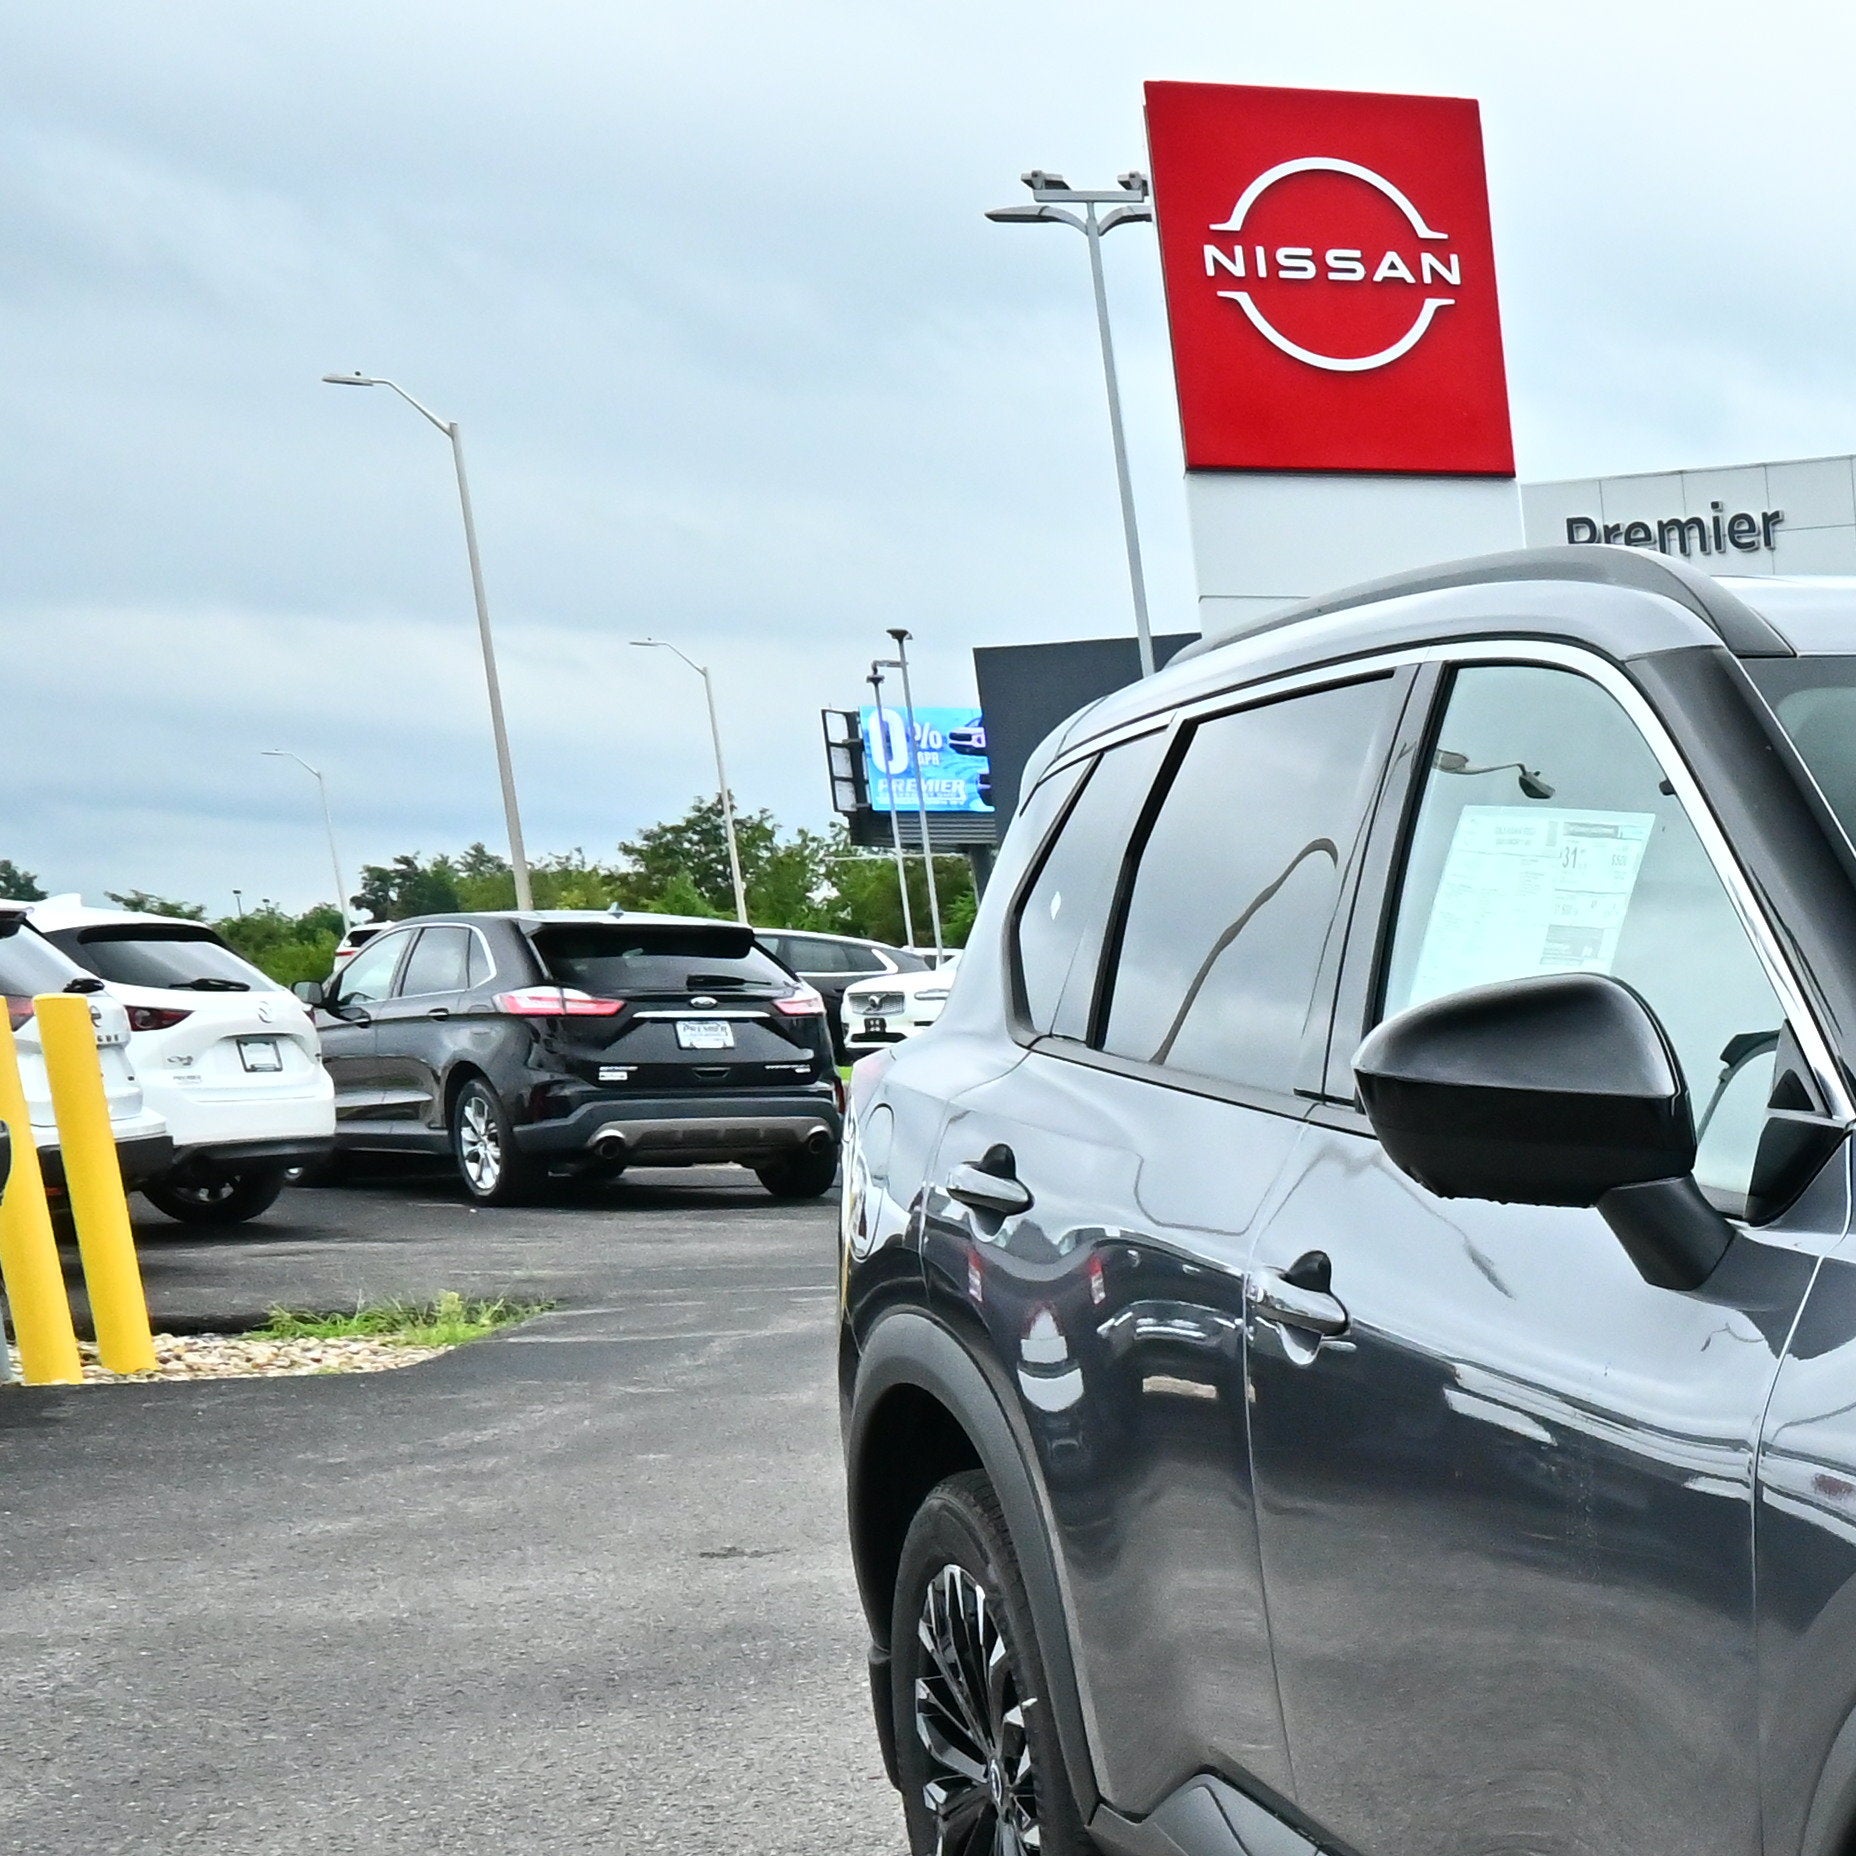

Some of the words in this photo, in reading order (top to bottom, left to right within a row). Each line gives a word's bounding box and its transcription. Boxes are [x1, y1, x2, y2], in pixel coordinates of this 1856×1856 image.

[1203, 244, 1461, 285] NISSAN
[877, 778, 967, 798] PREMIER
[1562, 846, 1578, 869] 31
